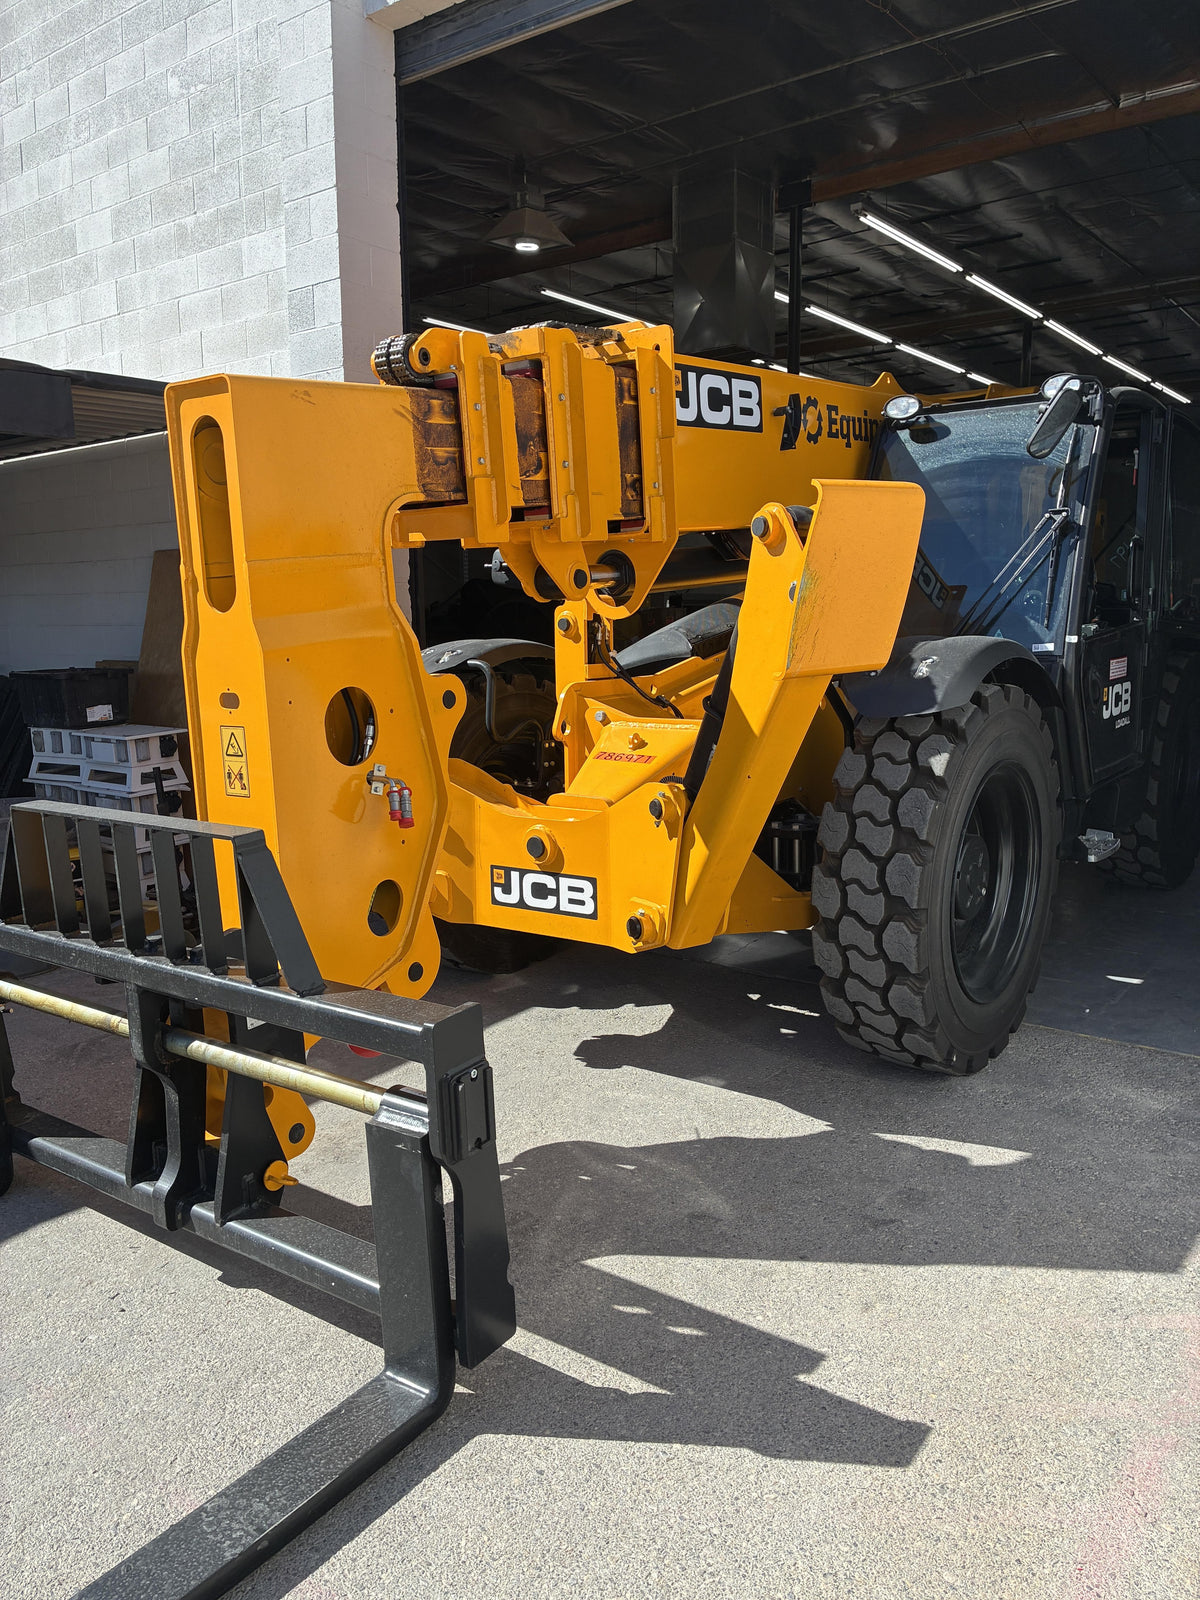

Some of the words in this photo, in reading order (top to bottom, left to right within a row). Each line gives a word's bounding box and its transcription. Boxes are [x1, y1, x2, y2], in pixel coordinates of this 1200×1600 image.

[675, 371, 761, 427] JCB
[1102, 681, 1132, 719] JCB
[595, 751, 652, 764] 786971
[493, 870, 595, 915] JCB
